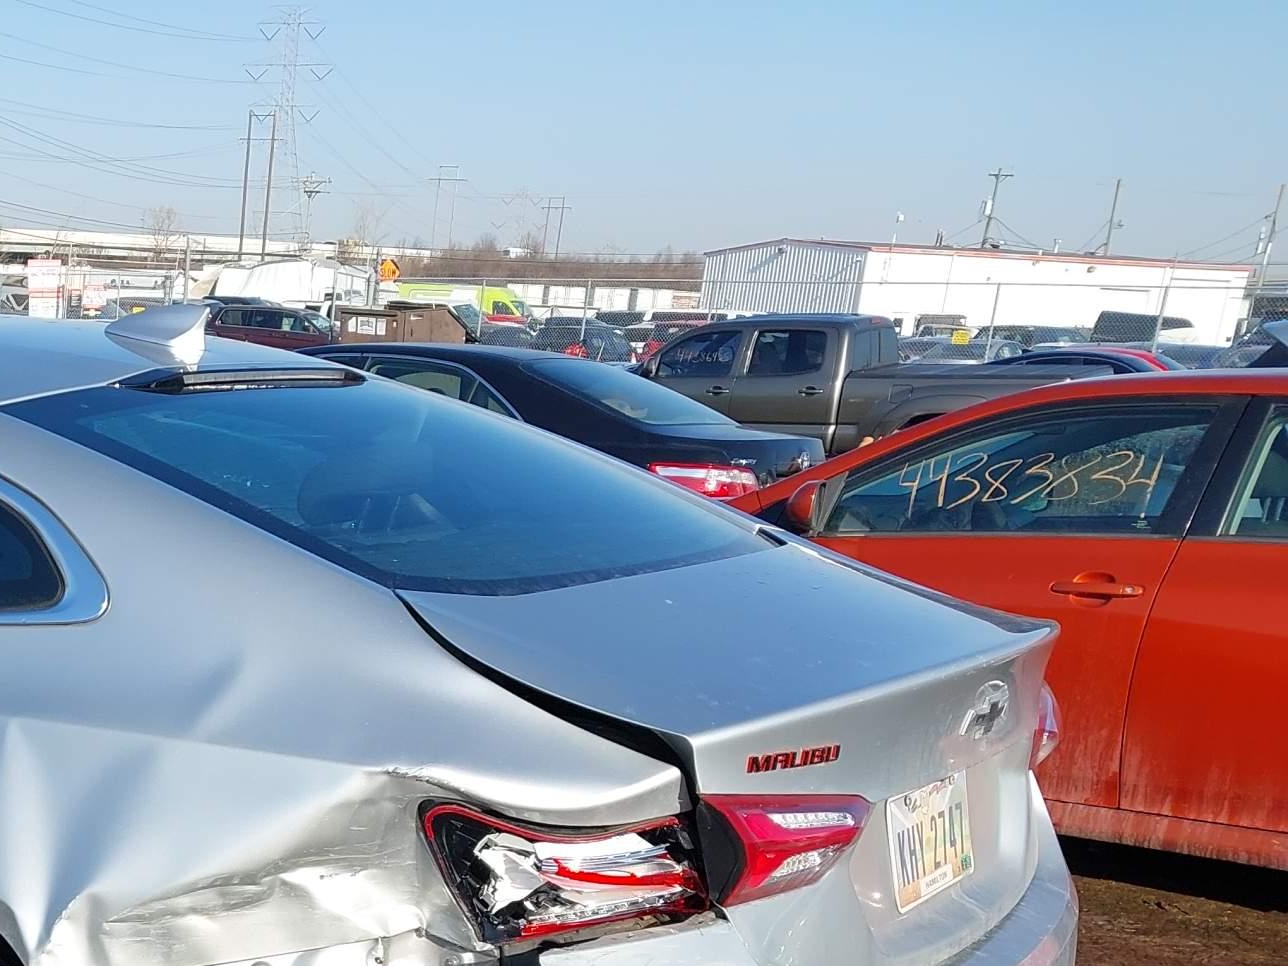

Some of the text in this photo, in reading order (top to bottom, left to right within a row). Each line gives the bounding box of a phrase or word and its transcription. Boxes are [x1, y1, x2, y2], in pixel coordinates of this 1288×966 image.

[899, 451, 1164, 520] 44383834
[745, 744, 841, 774] MALIBU
[897, 801, 965, 887] KHY 2747
